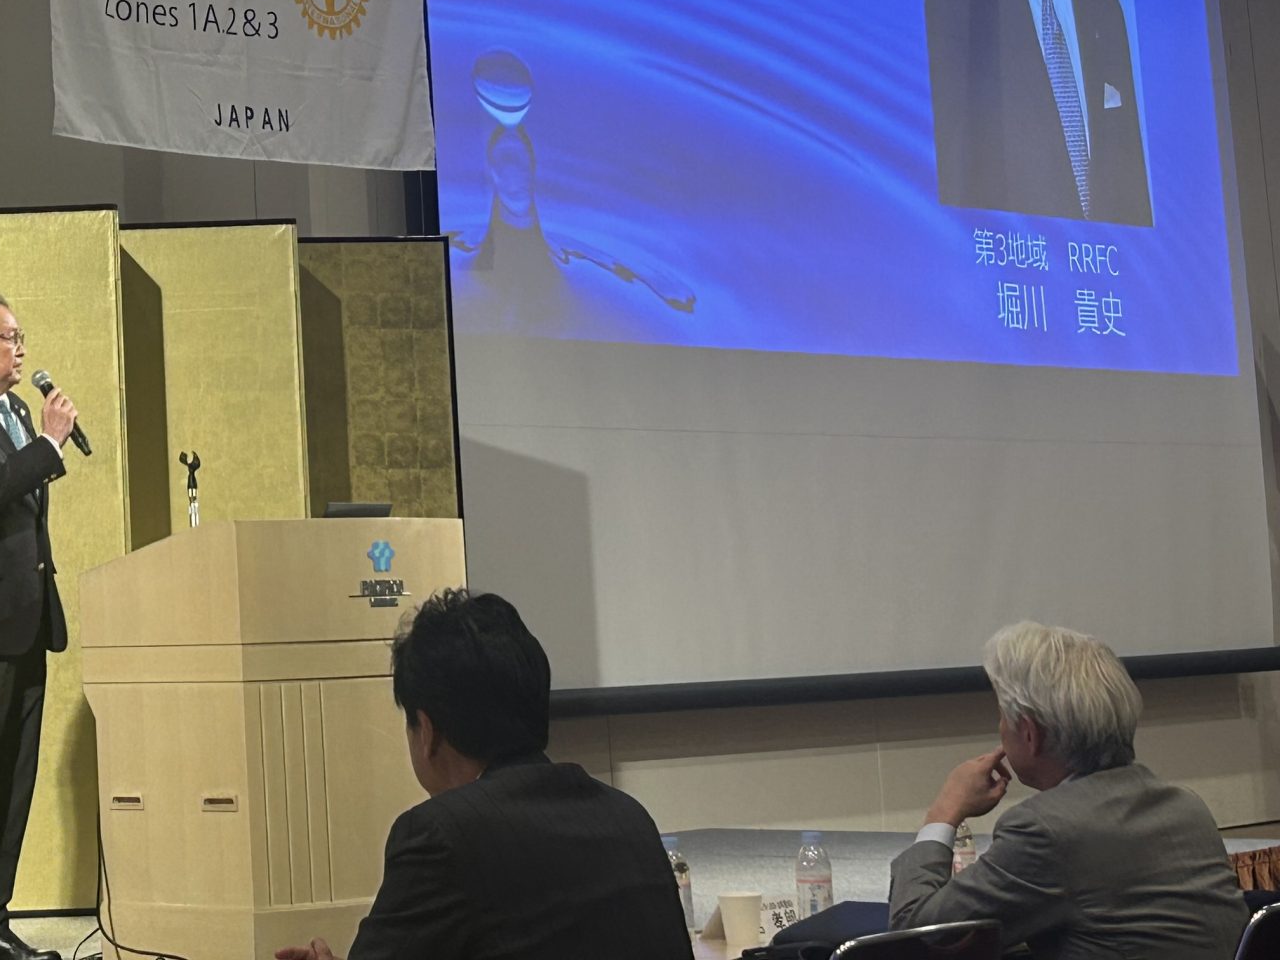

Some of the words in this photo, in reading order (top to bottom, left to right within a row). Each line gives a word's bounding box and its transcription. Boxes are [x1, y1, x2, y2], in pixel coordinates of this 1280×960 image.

[214, 103, 291, 133] JAPAN
[973, 227, 1049, 271] 第3地域
[1068, 242, 1119, 276] RRFC
[997, 281, 1047, 332] 堀川
[1074, 289, 1126, 336] 貴史
